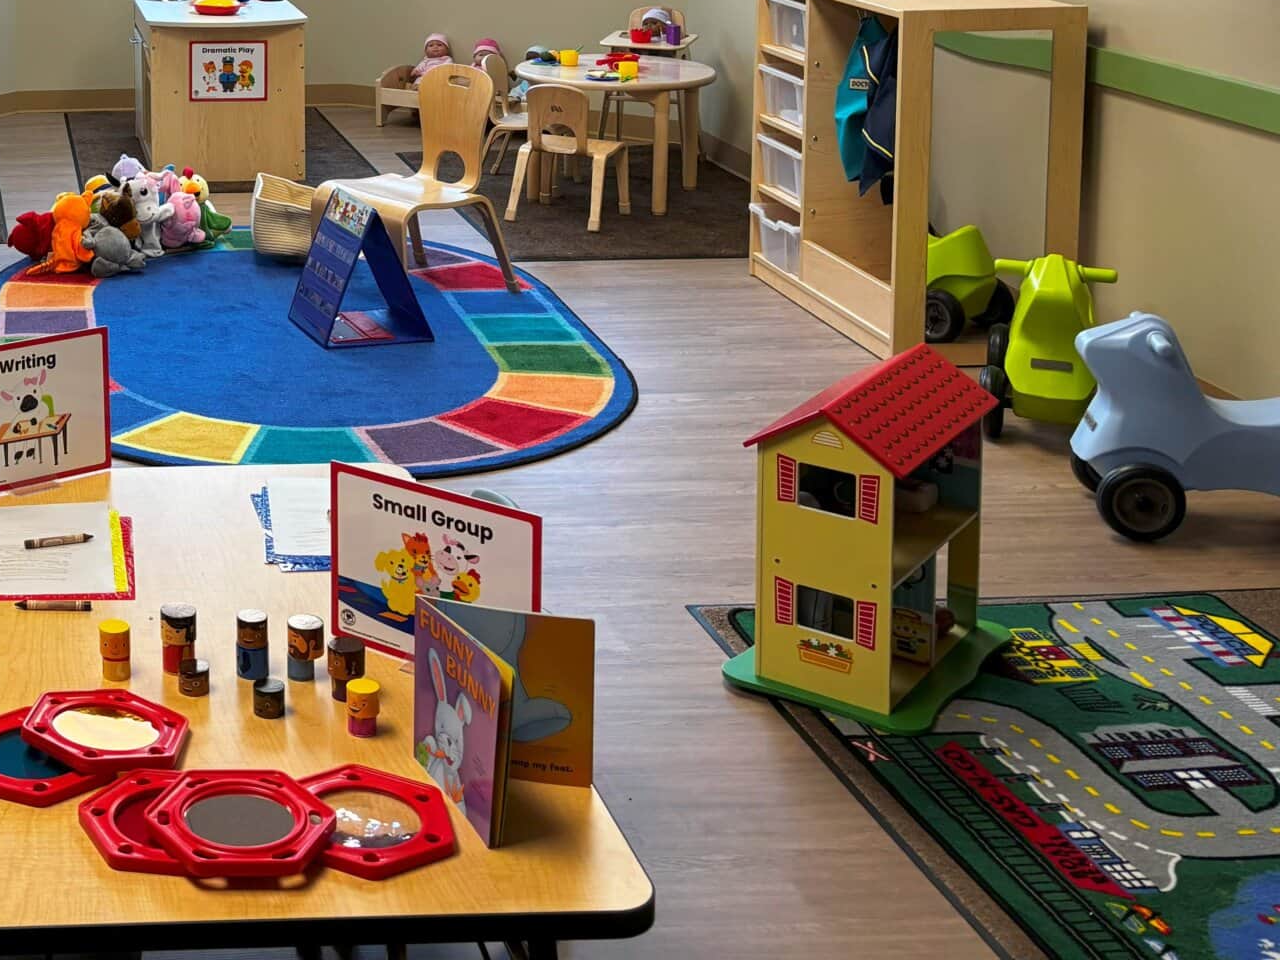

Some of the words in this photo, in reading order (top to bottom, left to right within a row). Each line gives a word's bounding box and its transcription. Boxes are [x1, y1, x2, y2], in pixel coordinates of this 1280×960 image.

[239, 47, 255, 55] Play
[0, 353, 57, 374] Writing
[372, 493, 427, 522] Small
[431, 510, 493, 544] Group
[420, 609, 475, 666] FUNNY
[447, 655, 496, 721] BUNNY
[1093, 727, 1188, 741] LIBRARY
